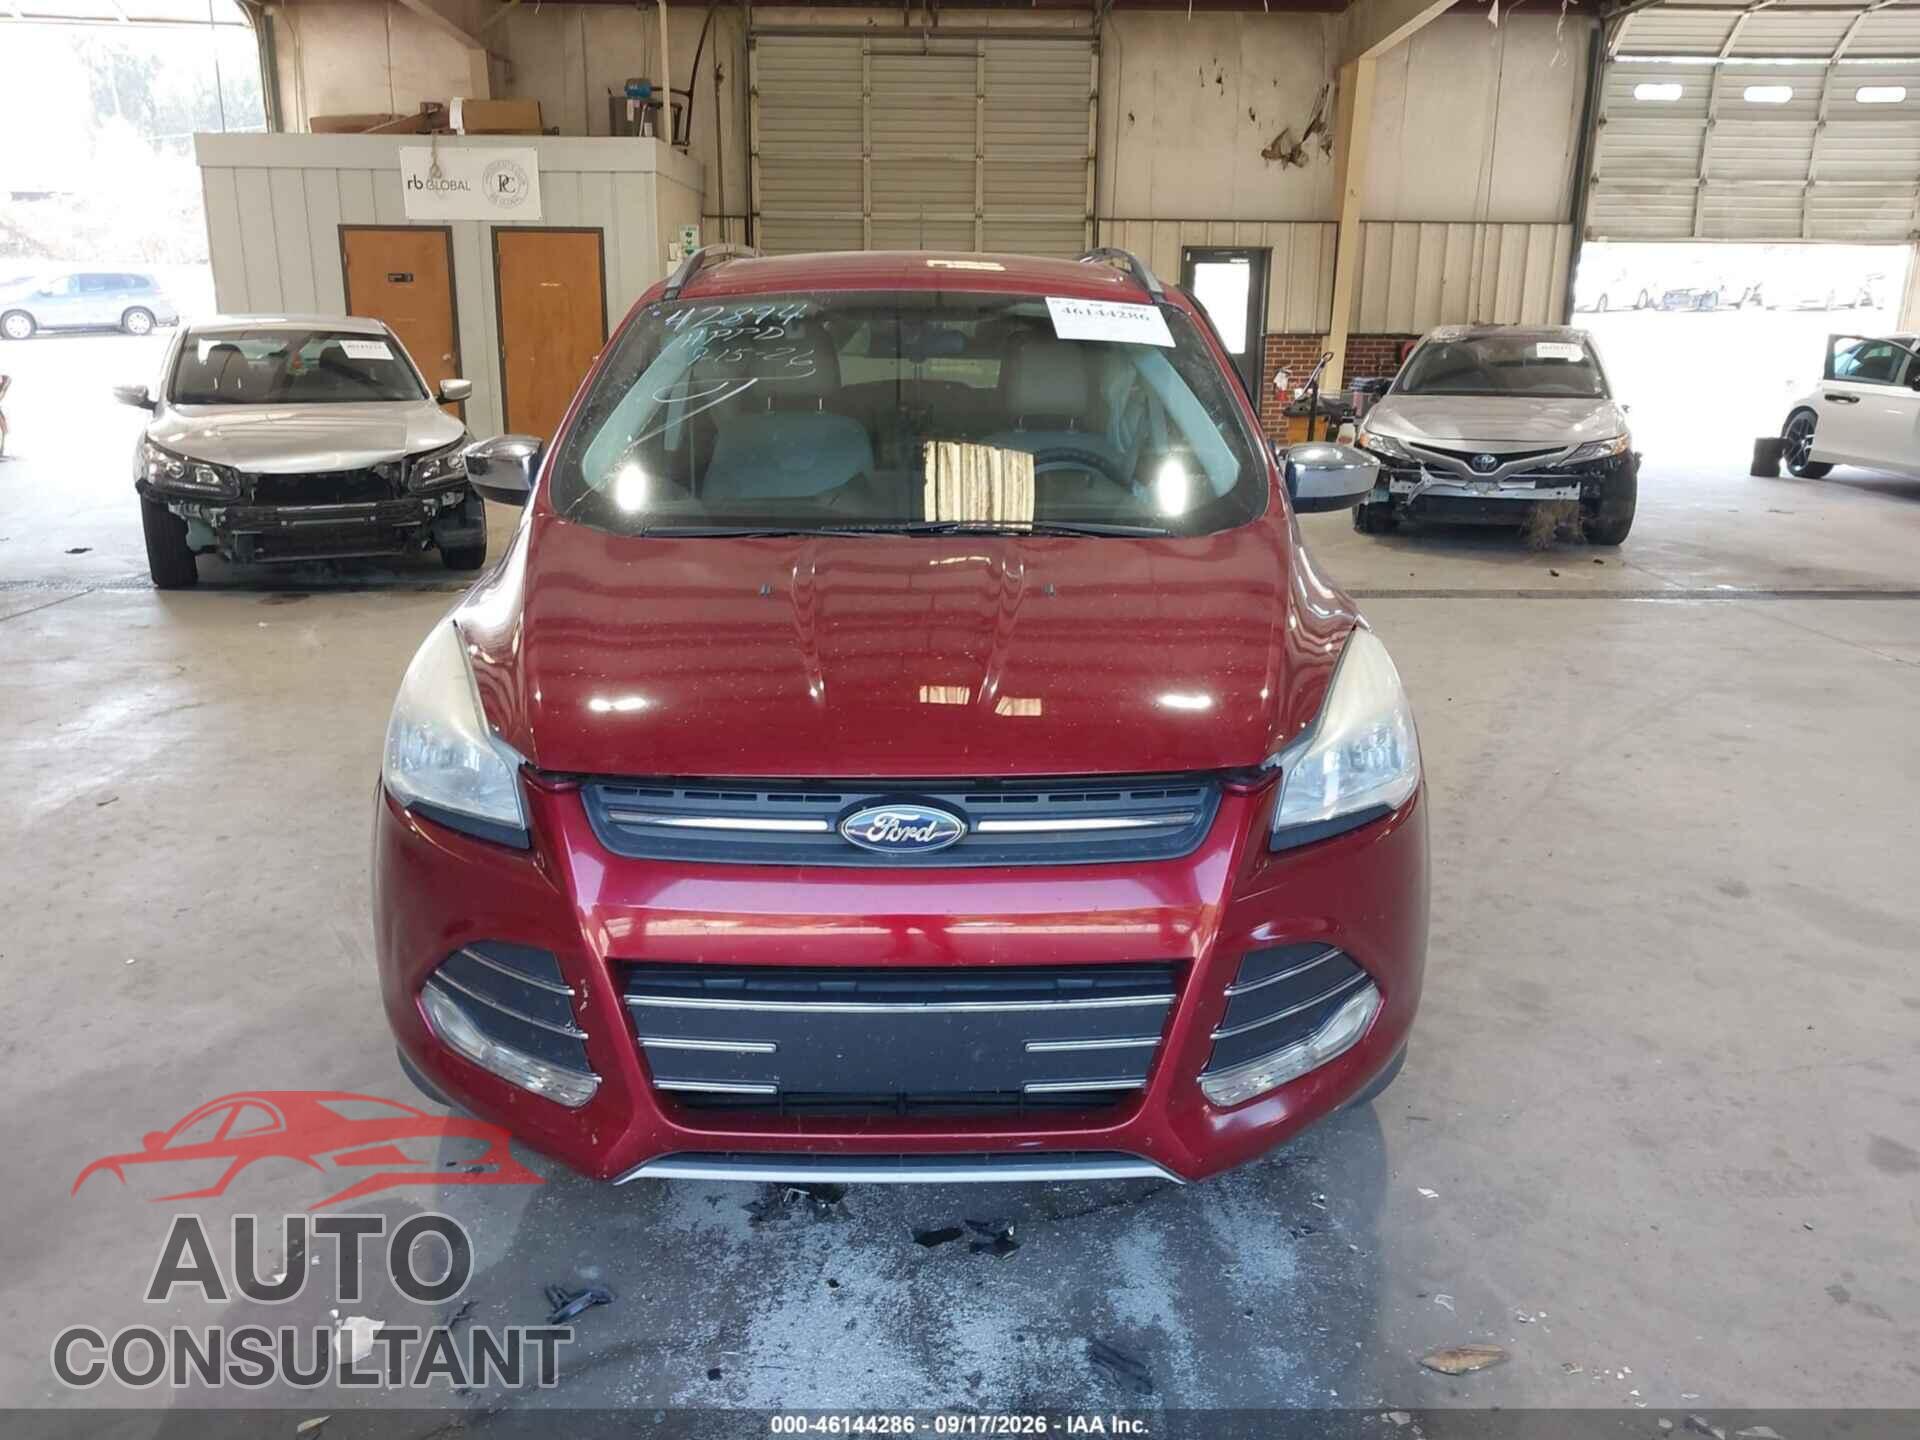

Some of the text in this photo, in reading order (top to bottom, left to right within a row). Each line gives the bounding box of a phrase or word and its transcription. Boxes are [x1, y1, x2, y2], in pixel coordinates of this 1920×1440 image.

[407, 174, 471, 191] rb GLOBAL
[866, 812, 937, 843] Ford
